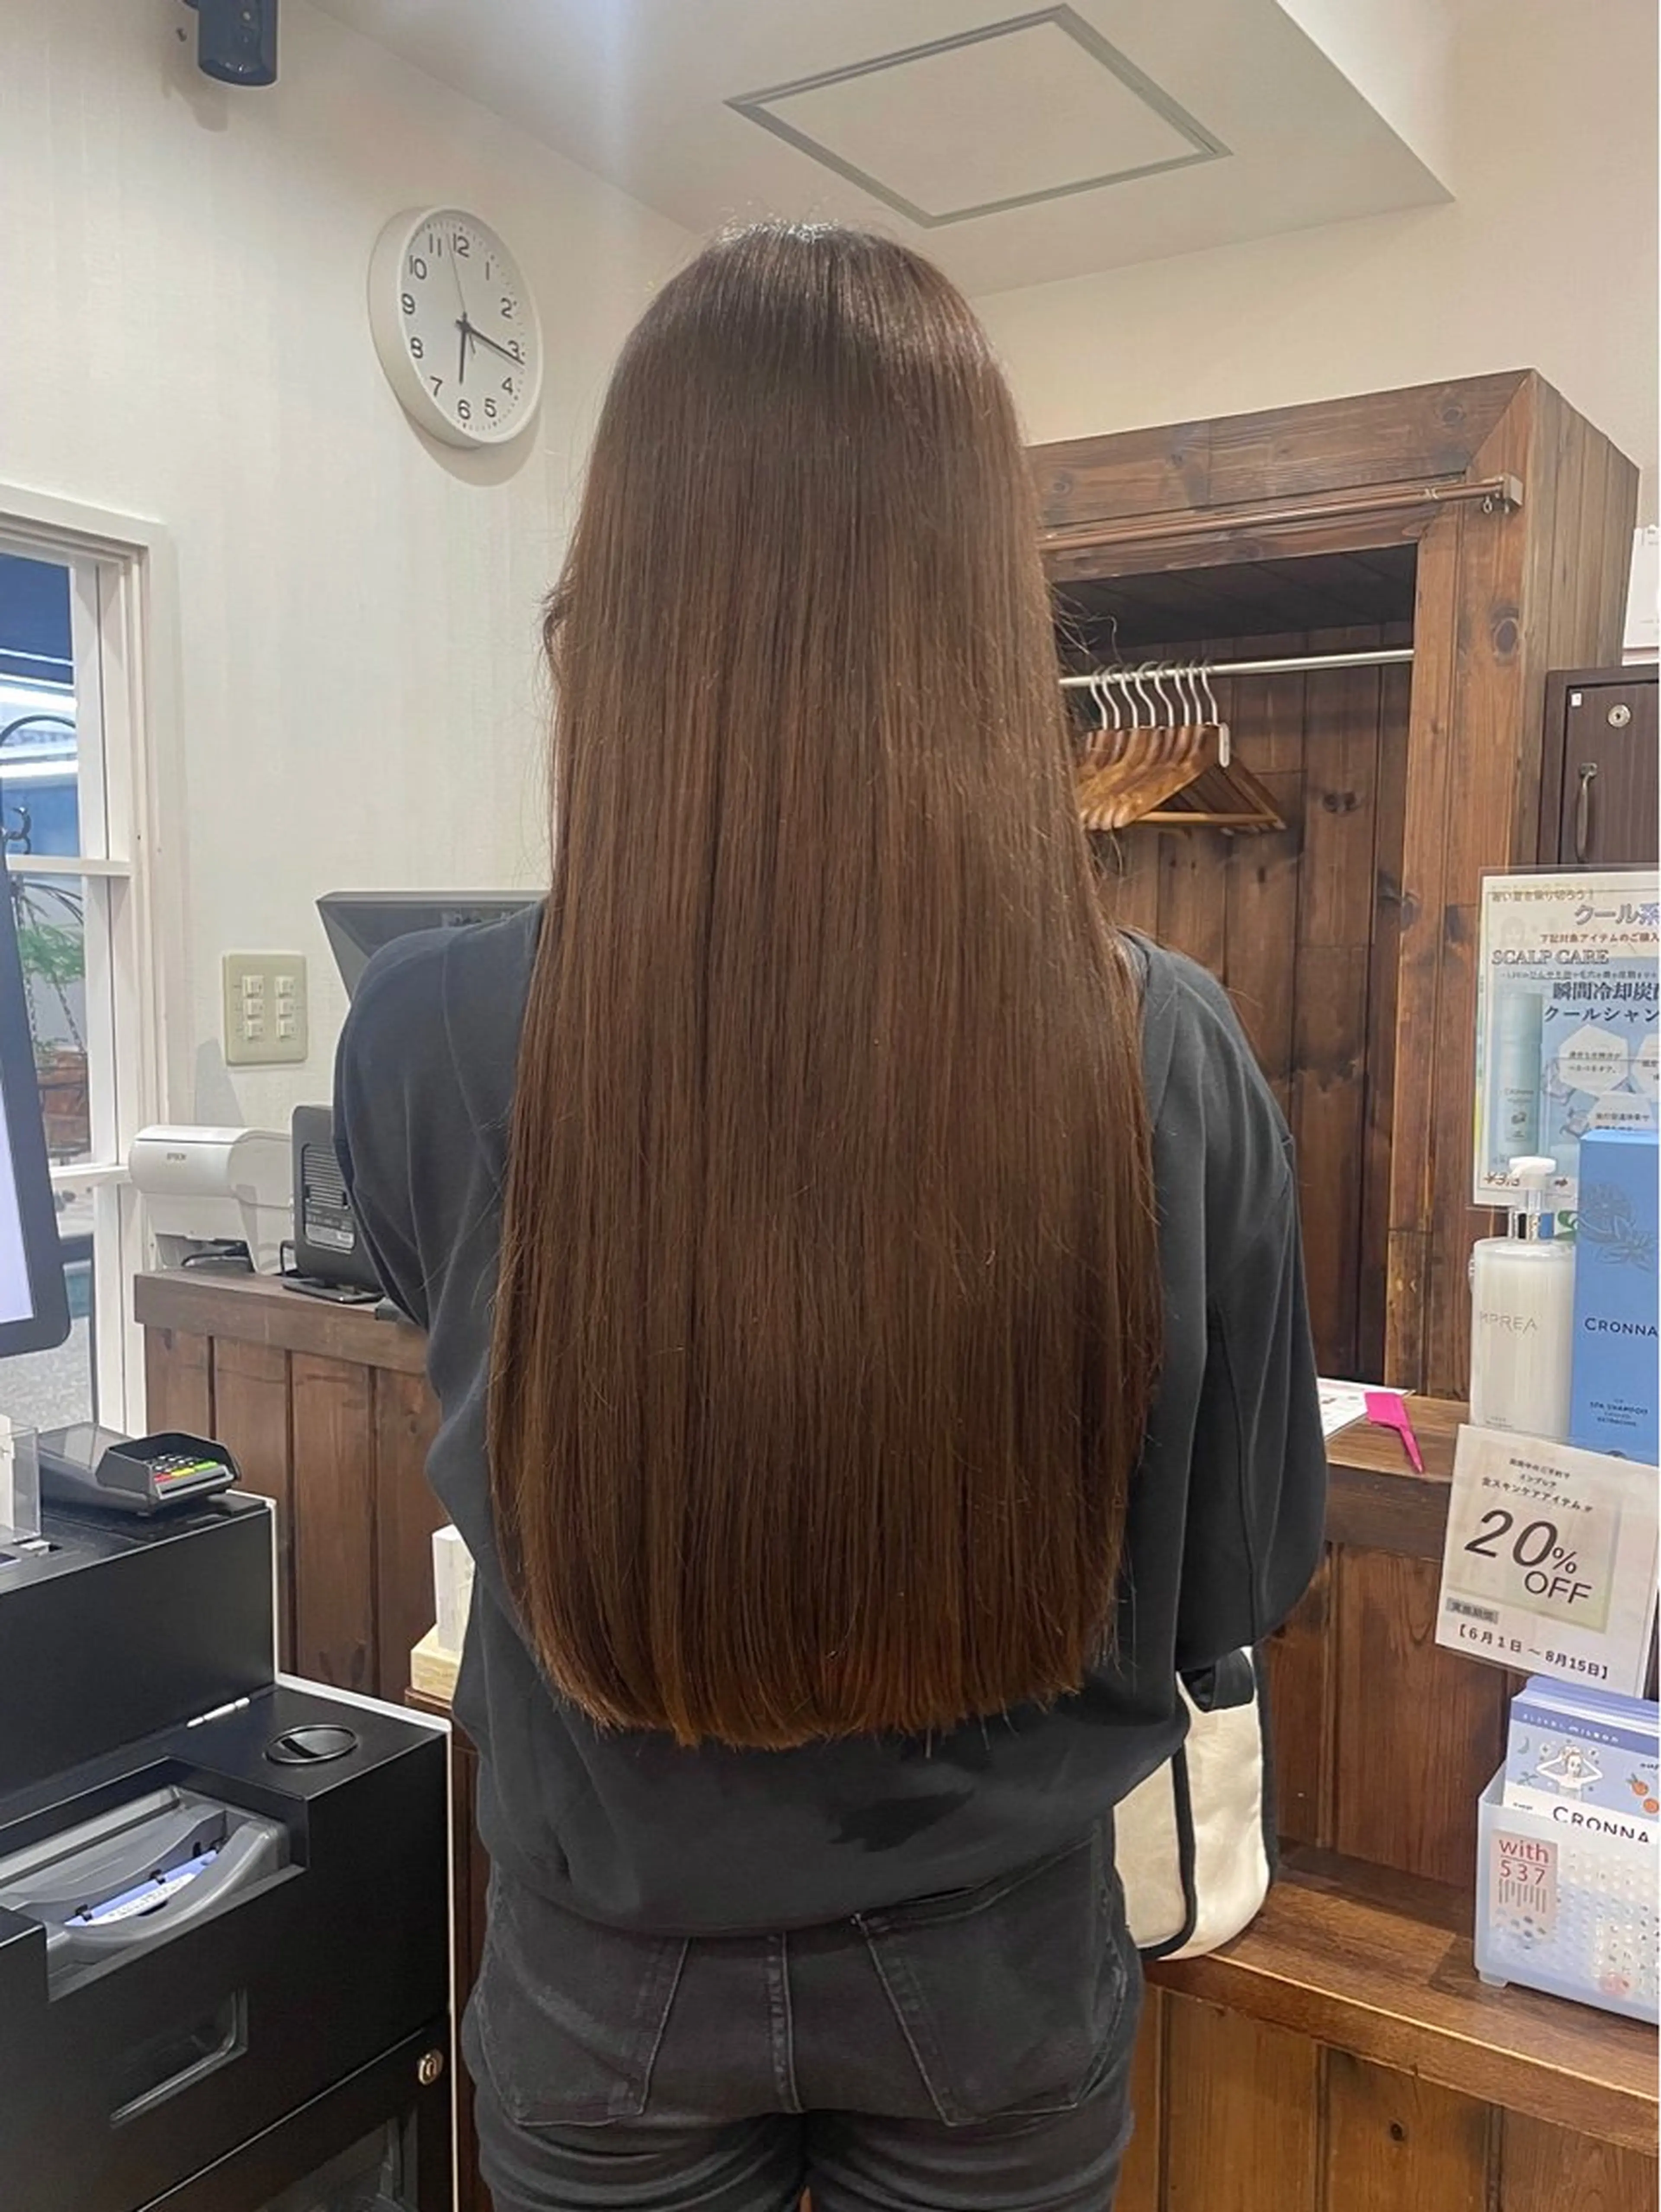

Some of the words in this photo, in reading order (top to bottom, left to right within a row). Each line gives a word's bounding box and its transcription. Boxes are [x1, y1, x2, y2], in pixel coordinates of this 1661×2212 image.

[429, 233, 442, 257] 11
[453, 233, 469, 257] 12
[410, 255, 427, 279] 10
[485, 261, 490, 281] 1
[401, 293, 415, 315] 9
[500, 297, 512, 319] 2
[410, 337, 423, 359] 8
[430, 375, 443, 397] 7
[502, 377, 513, 395] 4
[457, 399, 471, 420] 6
[484, 398, 497, 417] 5
[1491, 949, 1553, 965] SCALP
[1556, 949, 1610, 965] CARE
[1553, 981, 1659, 1001] 瞬間冷却炭
[1584, 1317, 1659, 1338] CRONNA
[1464, 1509, 1578, 1574] 20%
[1524, 1571, 1592, 1604] OFF
[1552, 1806, 1650, 1843] CRONNA
[1499, 1839, 1549, 1864] with
